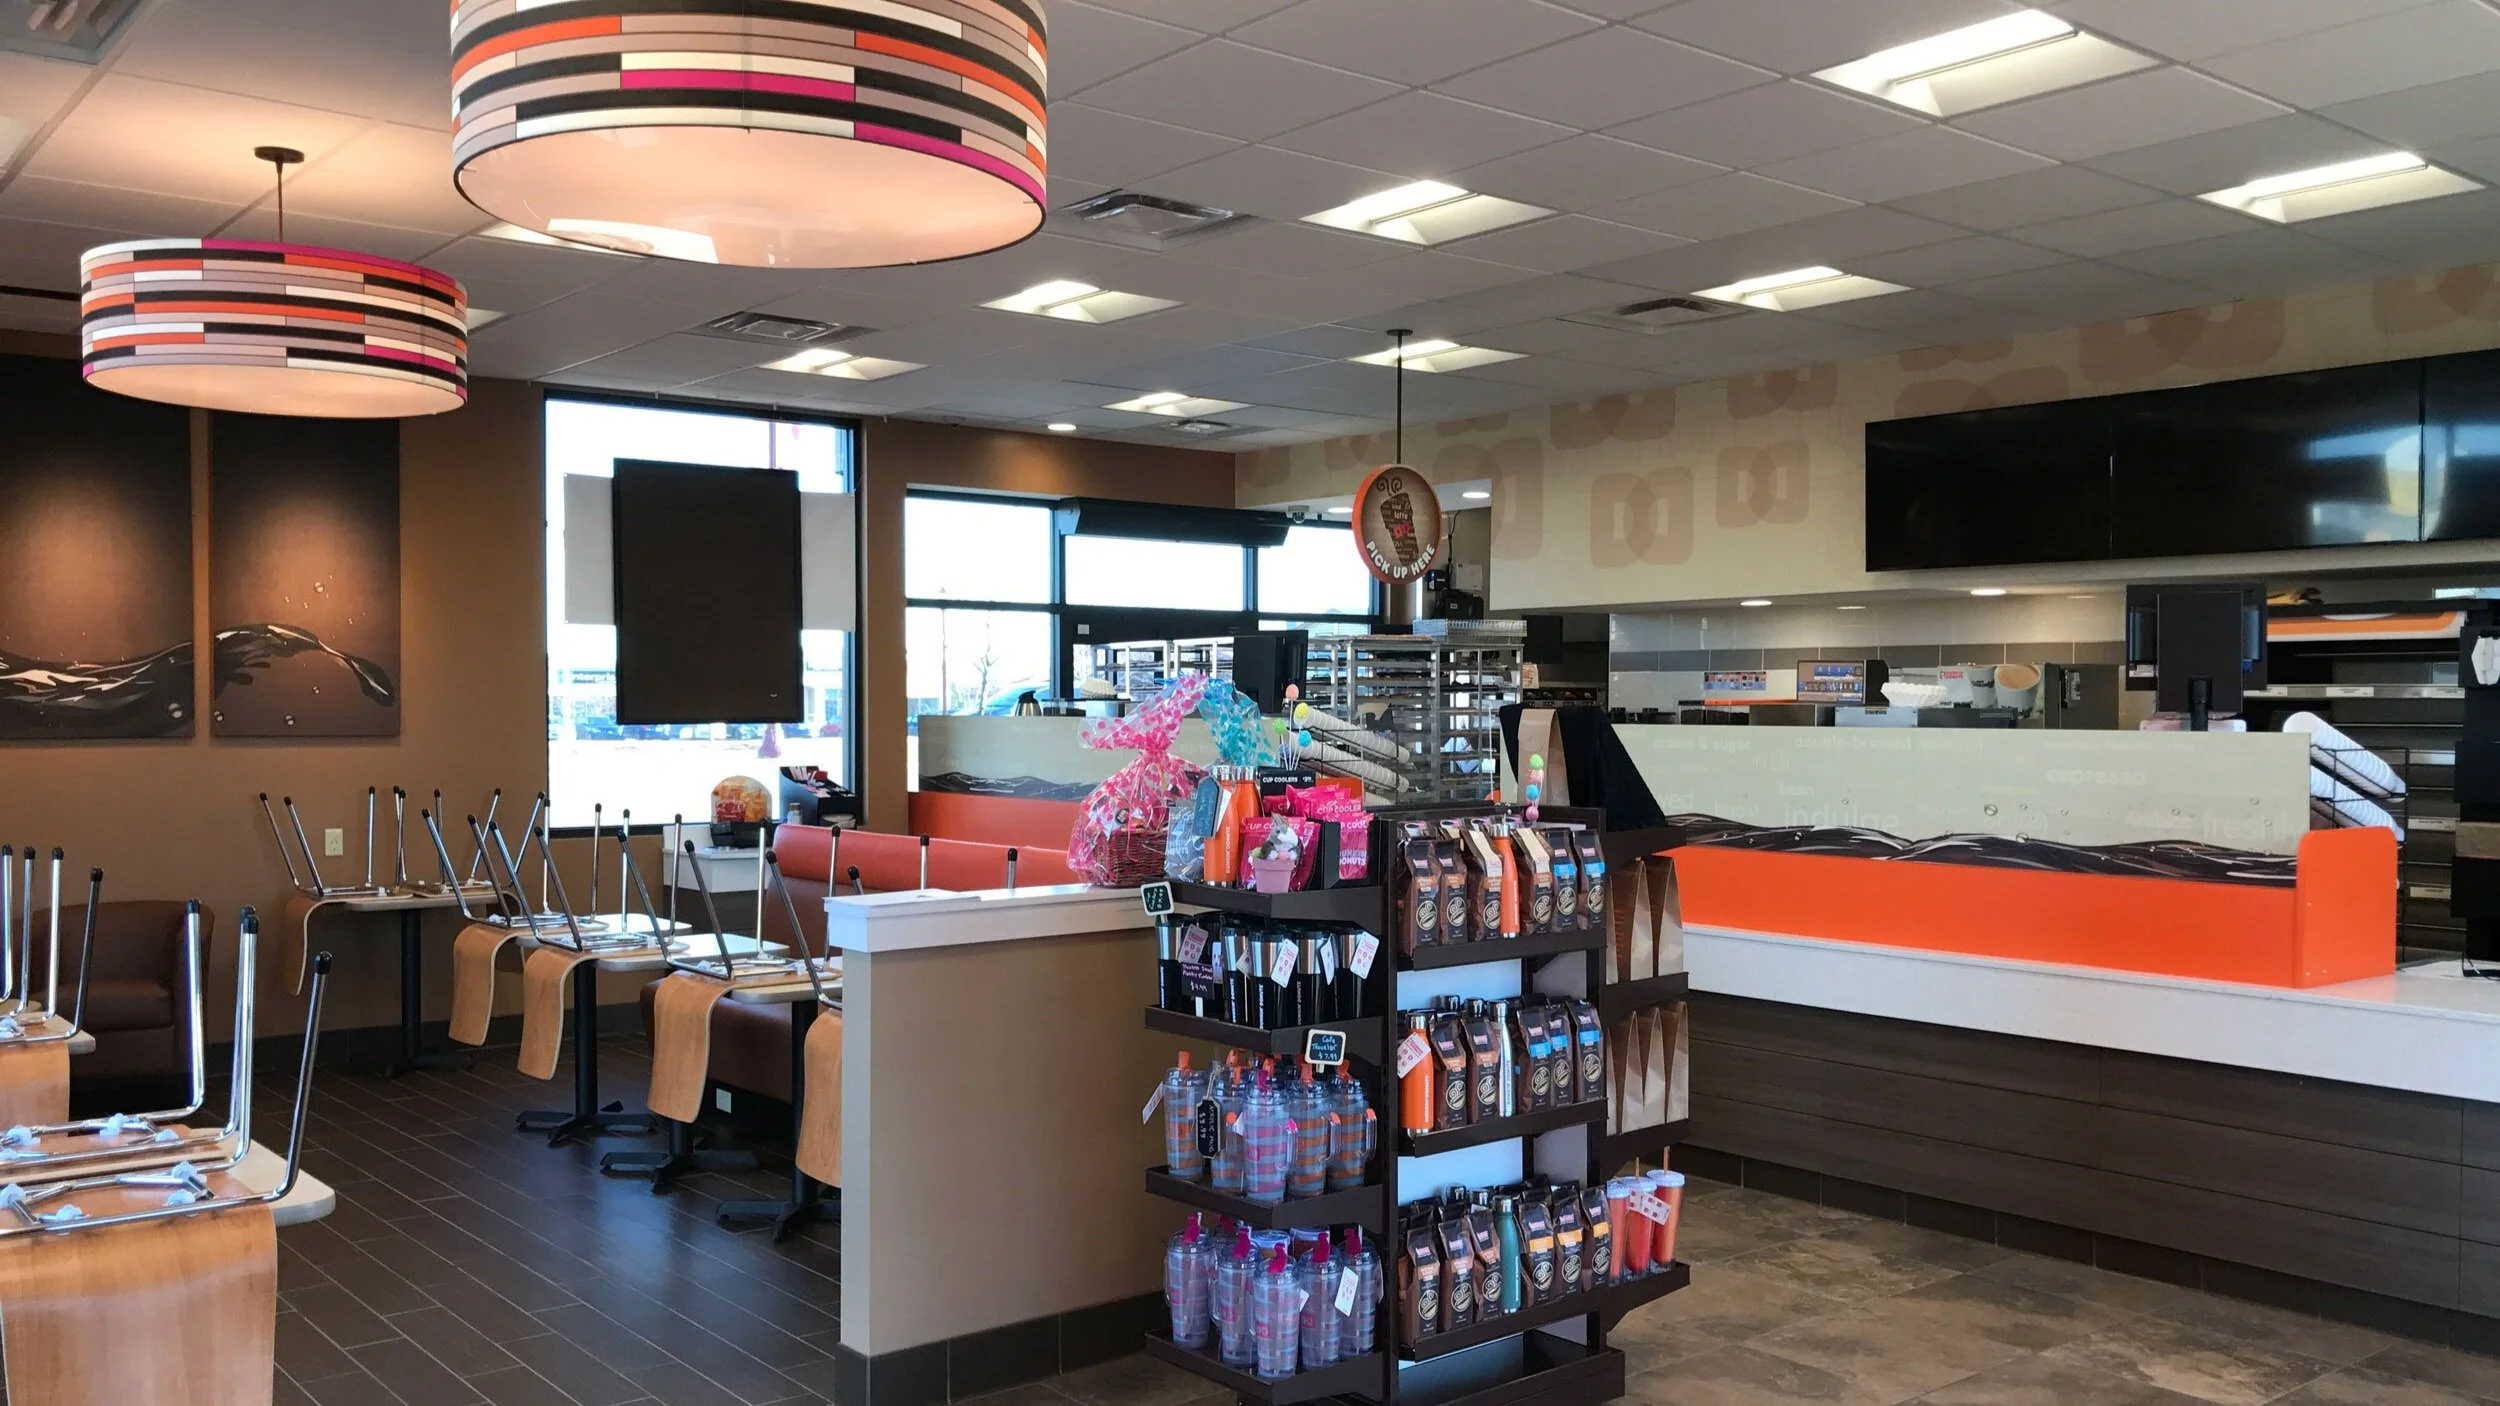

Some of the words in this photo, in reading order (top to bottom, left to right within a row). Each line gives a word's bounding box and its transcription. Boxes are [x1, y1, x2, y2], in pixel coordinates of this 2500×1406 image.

[1366, 540, 1391, 575] PICK
[1393, 566, 1408, 579] UP
[1410, 543, 1435, 576] HERE
[2045, 769, 2147, 789] espresso
[1334, 804, 1362, 813] COOLER
[1784, 801, 1901, 835] indulge
[1263, 822, 1300, 831] COER
